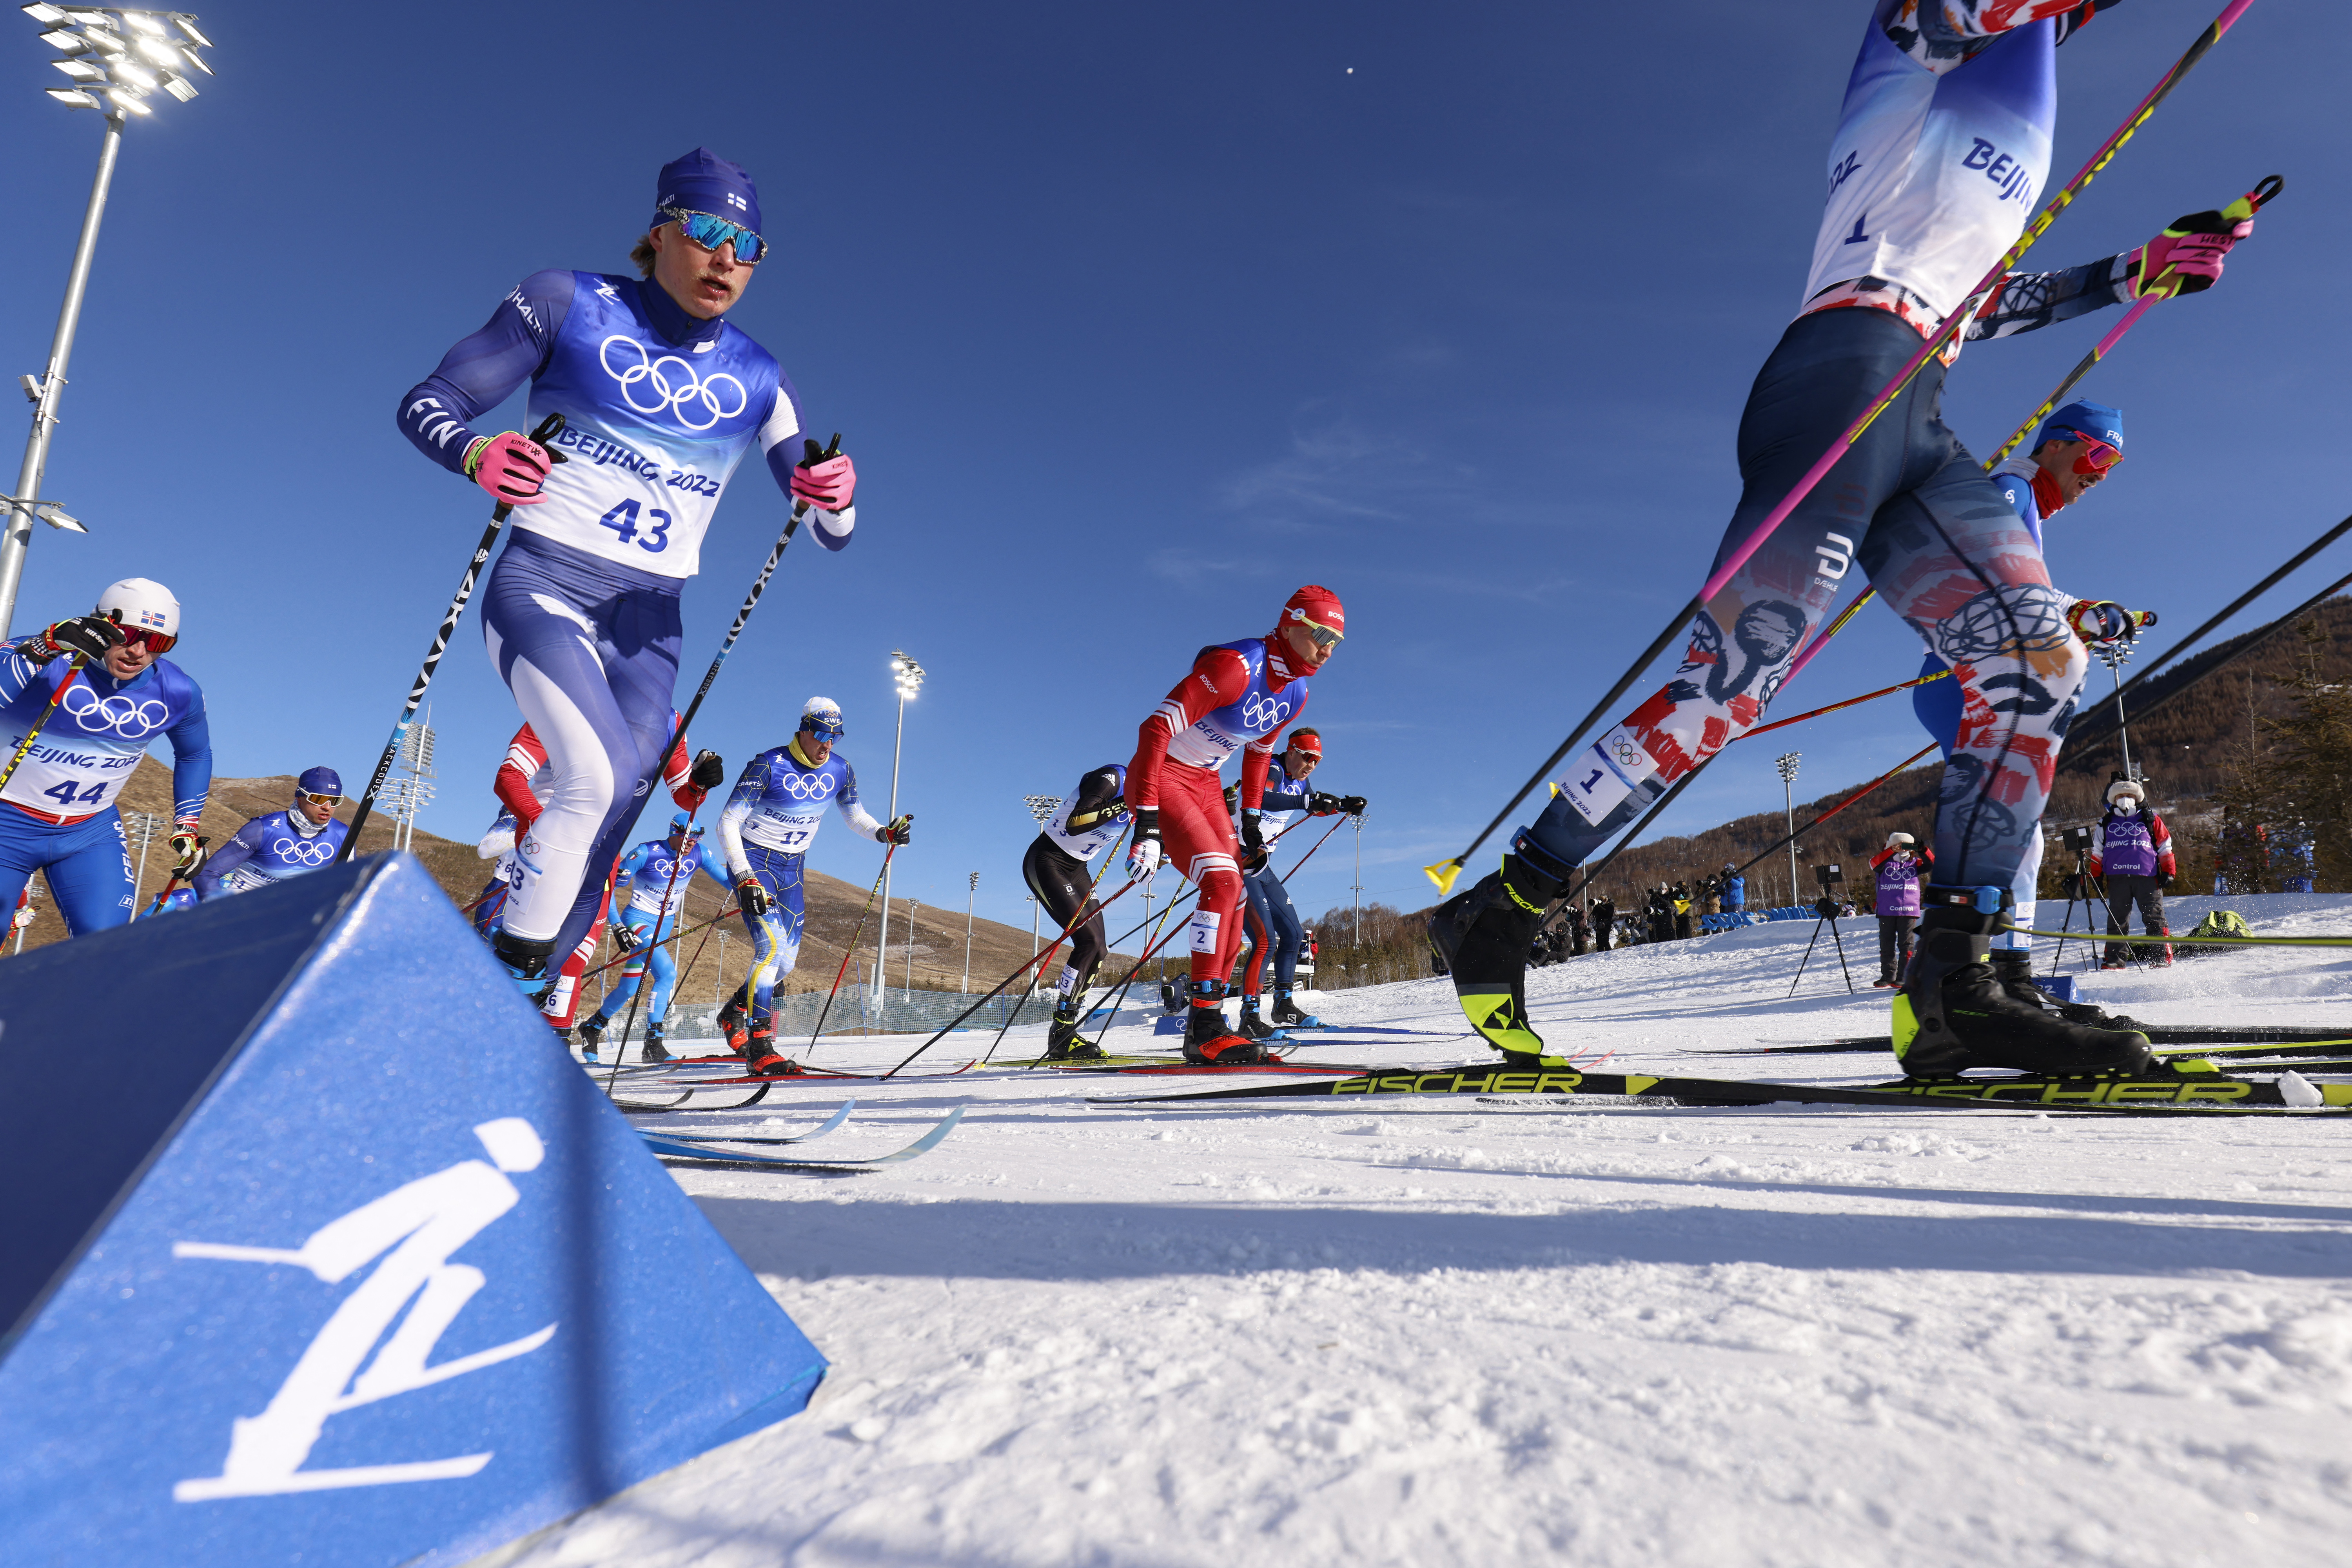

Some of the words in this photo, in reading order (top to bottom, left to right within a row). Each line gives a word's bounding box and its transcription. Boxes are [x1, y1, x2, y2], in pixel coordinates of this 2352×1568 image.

[1962, 137, 2033, 212] BEIJIN
[1844, 213, 1869, 245] 1
[2001, 188, 2073, 270] LEKI
[407, 398, 466, 449] FIN
[2001, 401, 2054, 459] LEKI
[557, 425, 661, 481] BEIJING
[666, 470, 720, 497] 2022
[599, 498, 671, 553] 43
[1328, 611, 1345, 622] BOSCO
[1199, 674, 1215, 692] BOSCO
[16, 730, 39, 763] LEKI
[1194, 720, 1240, 751] BEIJING
[9, 735, 97, 768] BEIJING
[44, 780, 109, 805] 44
[1101, 775, 1116, 787] adidas
[1580, 769, 1604, 795] 1
[1561, 782, 1577, 802] BEIJING
[1576, 800, 1592, 817] 2022
[764, 807, 805, 825] BEIJING
[236, 838, 250, 850] HALTI
[677, 820, 693, 863] SWIX
[780, 831, 808, 845] 17
[1090, 829, 1114, 842] IJING
[2131, 840, 2151, 848] 2022
[644, 884, 667, 895] BEIJIN
[1504, 883, 1546, 914] FISCHE
[1197, 931, 1205, 944] 2
[1060, 977, 1069, 988] 13
[549, 995, 557, 1006] 6
[1333, 1073, 1583, 1094] FISCHER
